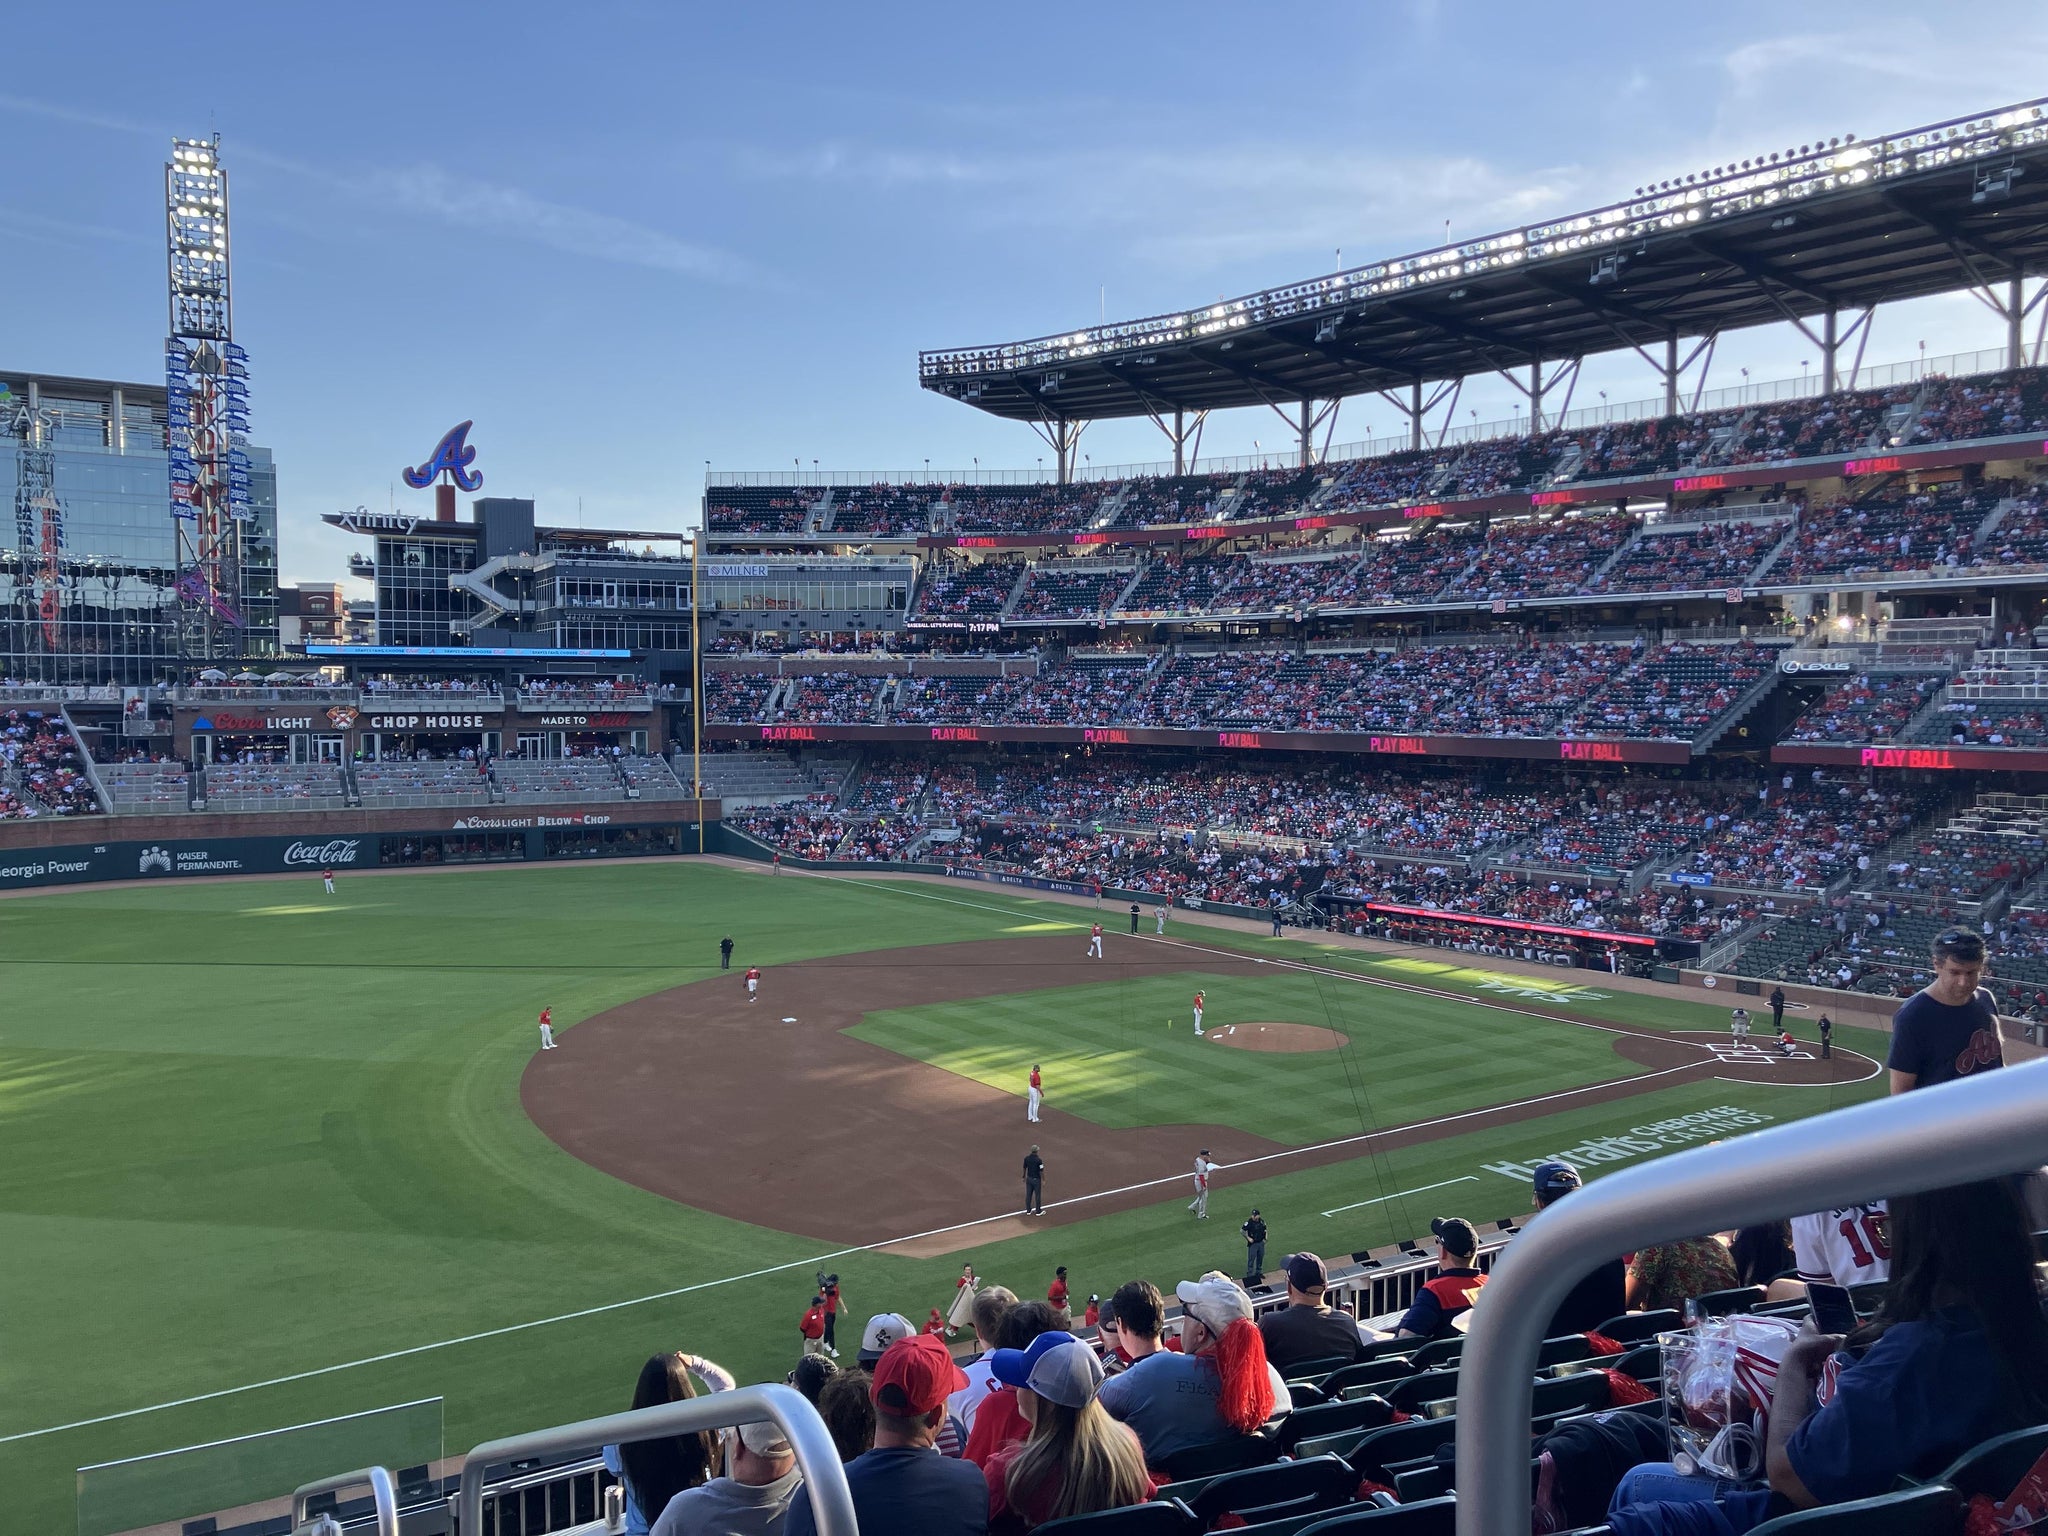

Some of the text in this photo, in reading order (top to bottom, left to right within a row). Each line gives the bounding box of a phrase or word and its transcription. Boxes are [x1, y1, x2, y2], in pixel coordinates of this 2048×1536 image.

[168, 342, 186, 353] 1996
[226, 347, 243, 358] 1997
[169, 359, 187, 371] 1998
[227, 364, 244, 375] 1999
[169, 377, 188, 389] 2000
[227, 382, 245, 393] 2001
[228, 400, 246, 411] 2003
[170, 413, 189, 425] 2004
[229, 418, 246, 429] 2005
[171, 432, 188, 443] 2010
[230, 435, 246, 447] 2012
[172, 449, 189, 461] 2013
[1845, 456, 1900, 475] PLAY BALL
[172, 467, 189, 480] 2019
[230, 470, 247, 482] 2020
[1674, 476, 1726, 492] PLAY BALL
[173, 486, 190, 497] 2021
[230, 488, 248, 500] 2022
[173, 503, 191, 515] 2023
[231, 506, 248, 518] 2024
[338, 505, 420, 535] xfinity
[1074, 533, 1107, 545] PLAY BALL
[1187, 527, 1226, 539] PLAY BALL
[957, 538, 997, 547] PLAY BALL
[722, 565, 768, 577] MILNER
[1726, 588, 1742, 603] 21
[1492, 600, 1506, 613] 10
[969, 623, 999, 632] 7:17 PM
[1800, 662, 1850, 671] LEXUS
[213, 712, 312, 730] Coors LIGHT
[371, 715, 483, 728] CHOP HOUSE
[541, 716, 571, 725] MADE
[573, 716, 587, 725] TO
[762, 727, 815, 740] PLAY BALL
[932, 728, 978, 741] PLAY BALL
[1084, 730, 1129, 743] PLAY BALL
[1219, 733, 1261, 748] PLAY BALL
[1371, 737, 1426, 754] PLAY BALL
[1561, 742, 1622, 761] PLAY BALL
[1861, 748, 1955, 769] PLAY BALL
[467, 816, 502, 828] Coors
[502, 818, 532, 827] LIGHT
[537, 816, 572, 826] BELOW
[583, 815, 610, 825] CHOP
[94, 846, 106, 854] 375
[177, 851, 208, 861] KAISER
[284, 840, 360, 865] Coca-Cola
[48, 861, 89, 873] Power
[177, 860, 240, 871] PERMANENTE
[1006, 876, 1023, 884] DELTA
[1629, 1105, 1748, 1137] CHEROKEE
[1657, 1112, 1775, 1144] CASINOS
